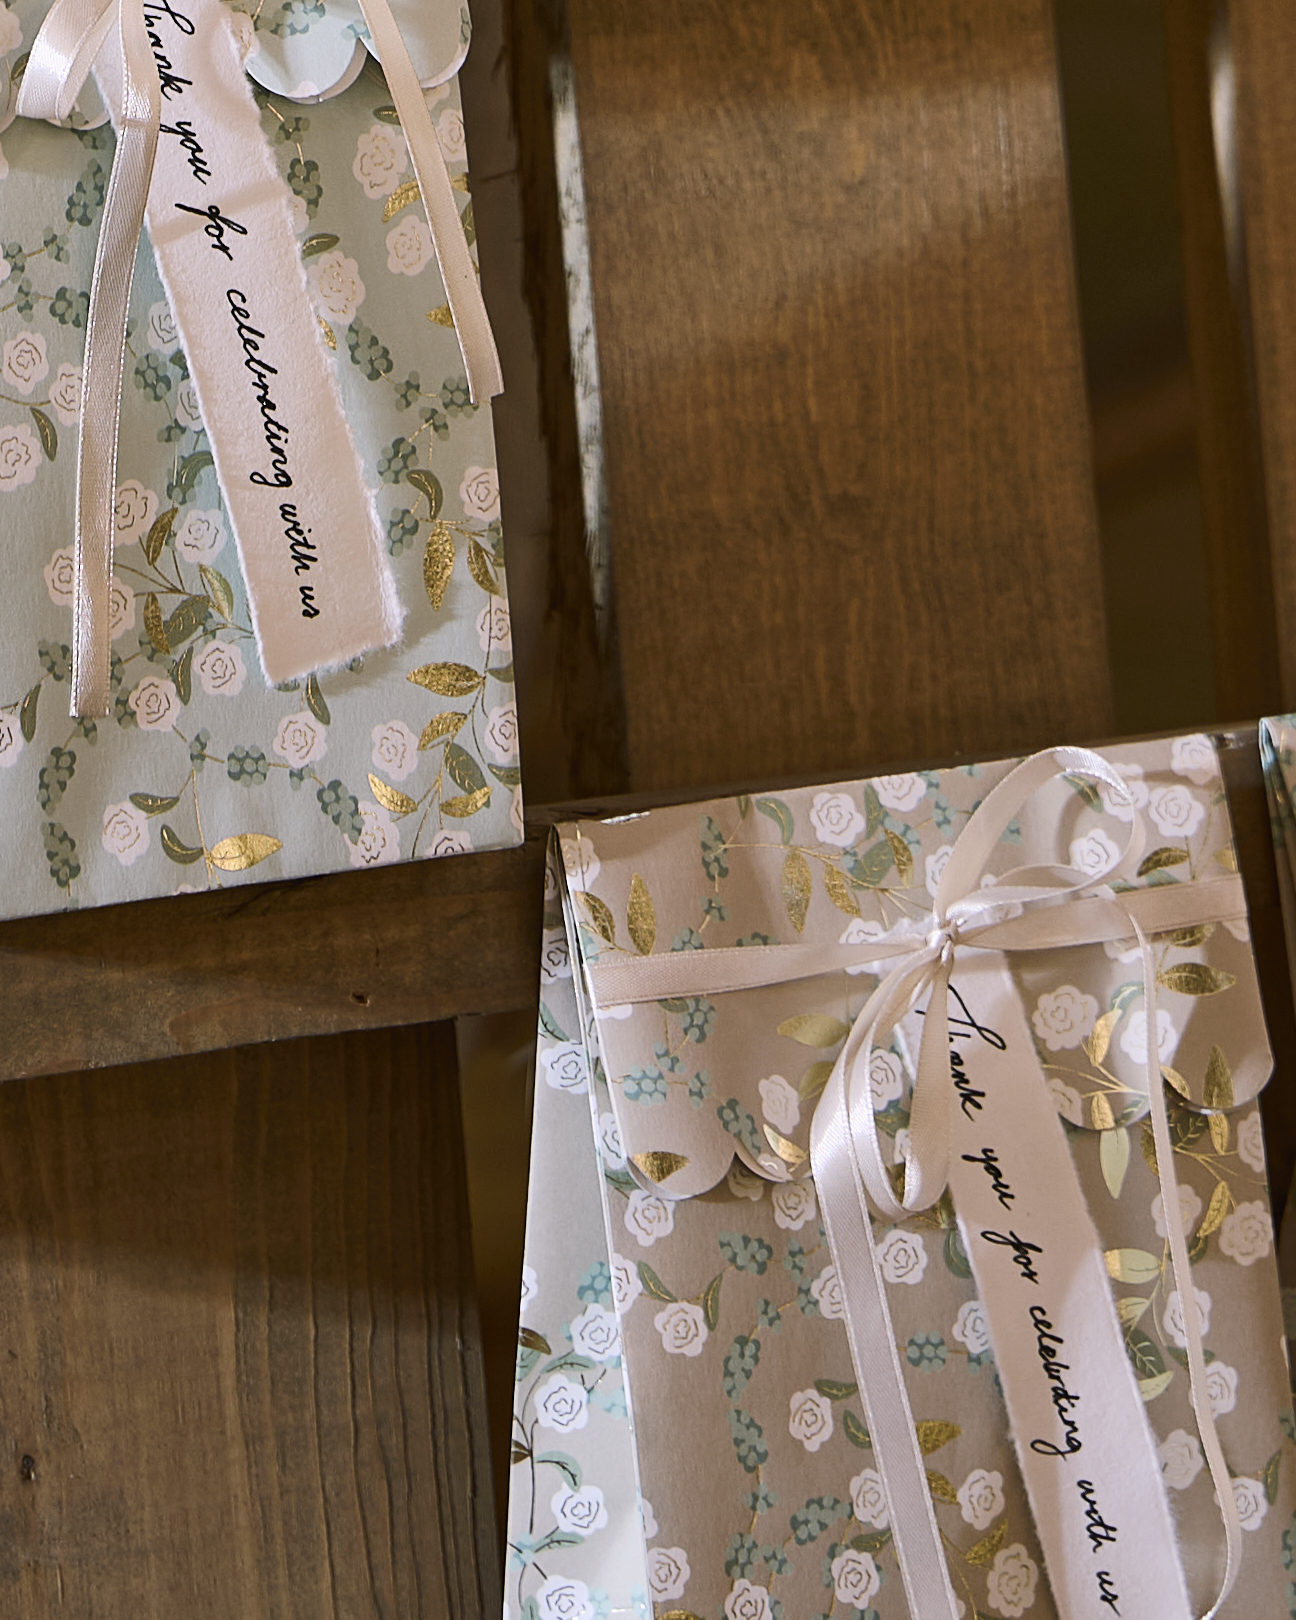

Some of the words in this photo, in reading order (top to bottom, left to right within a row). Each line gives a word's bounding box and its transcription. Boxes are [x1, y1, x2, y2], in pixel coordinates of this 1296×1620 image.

[159, 120, 212, 186] you
[174, 203, 248, 262] for
[226, 288, 293, 489] celebrating
[278, 503, 311, 577] with
[298, 585, 321, 620] us
[960, 1147, 1016, 1211] you
[980, 1230, 1044, 1285] for
[1028, 1305, 1082, 1460] celebrating
[1076, 1479, 1117, 1554] with
[1095, 1570, 1121, 1617] us
